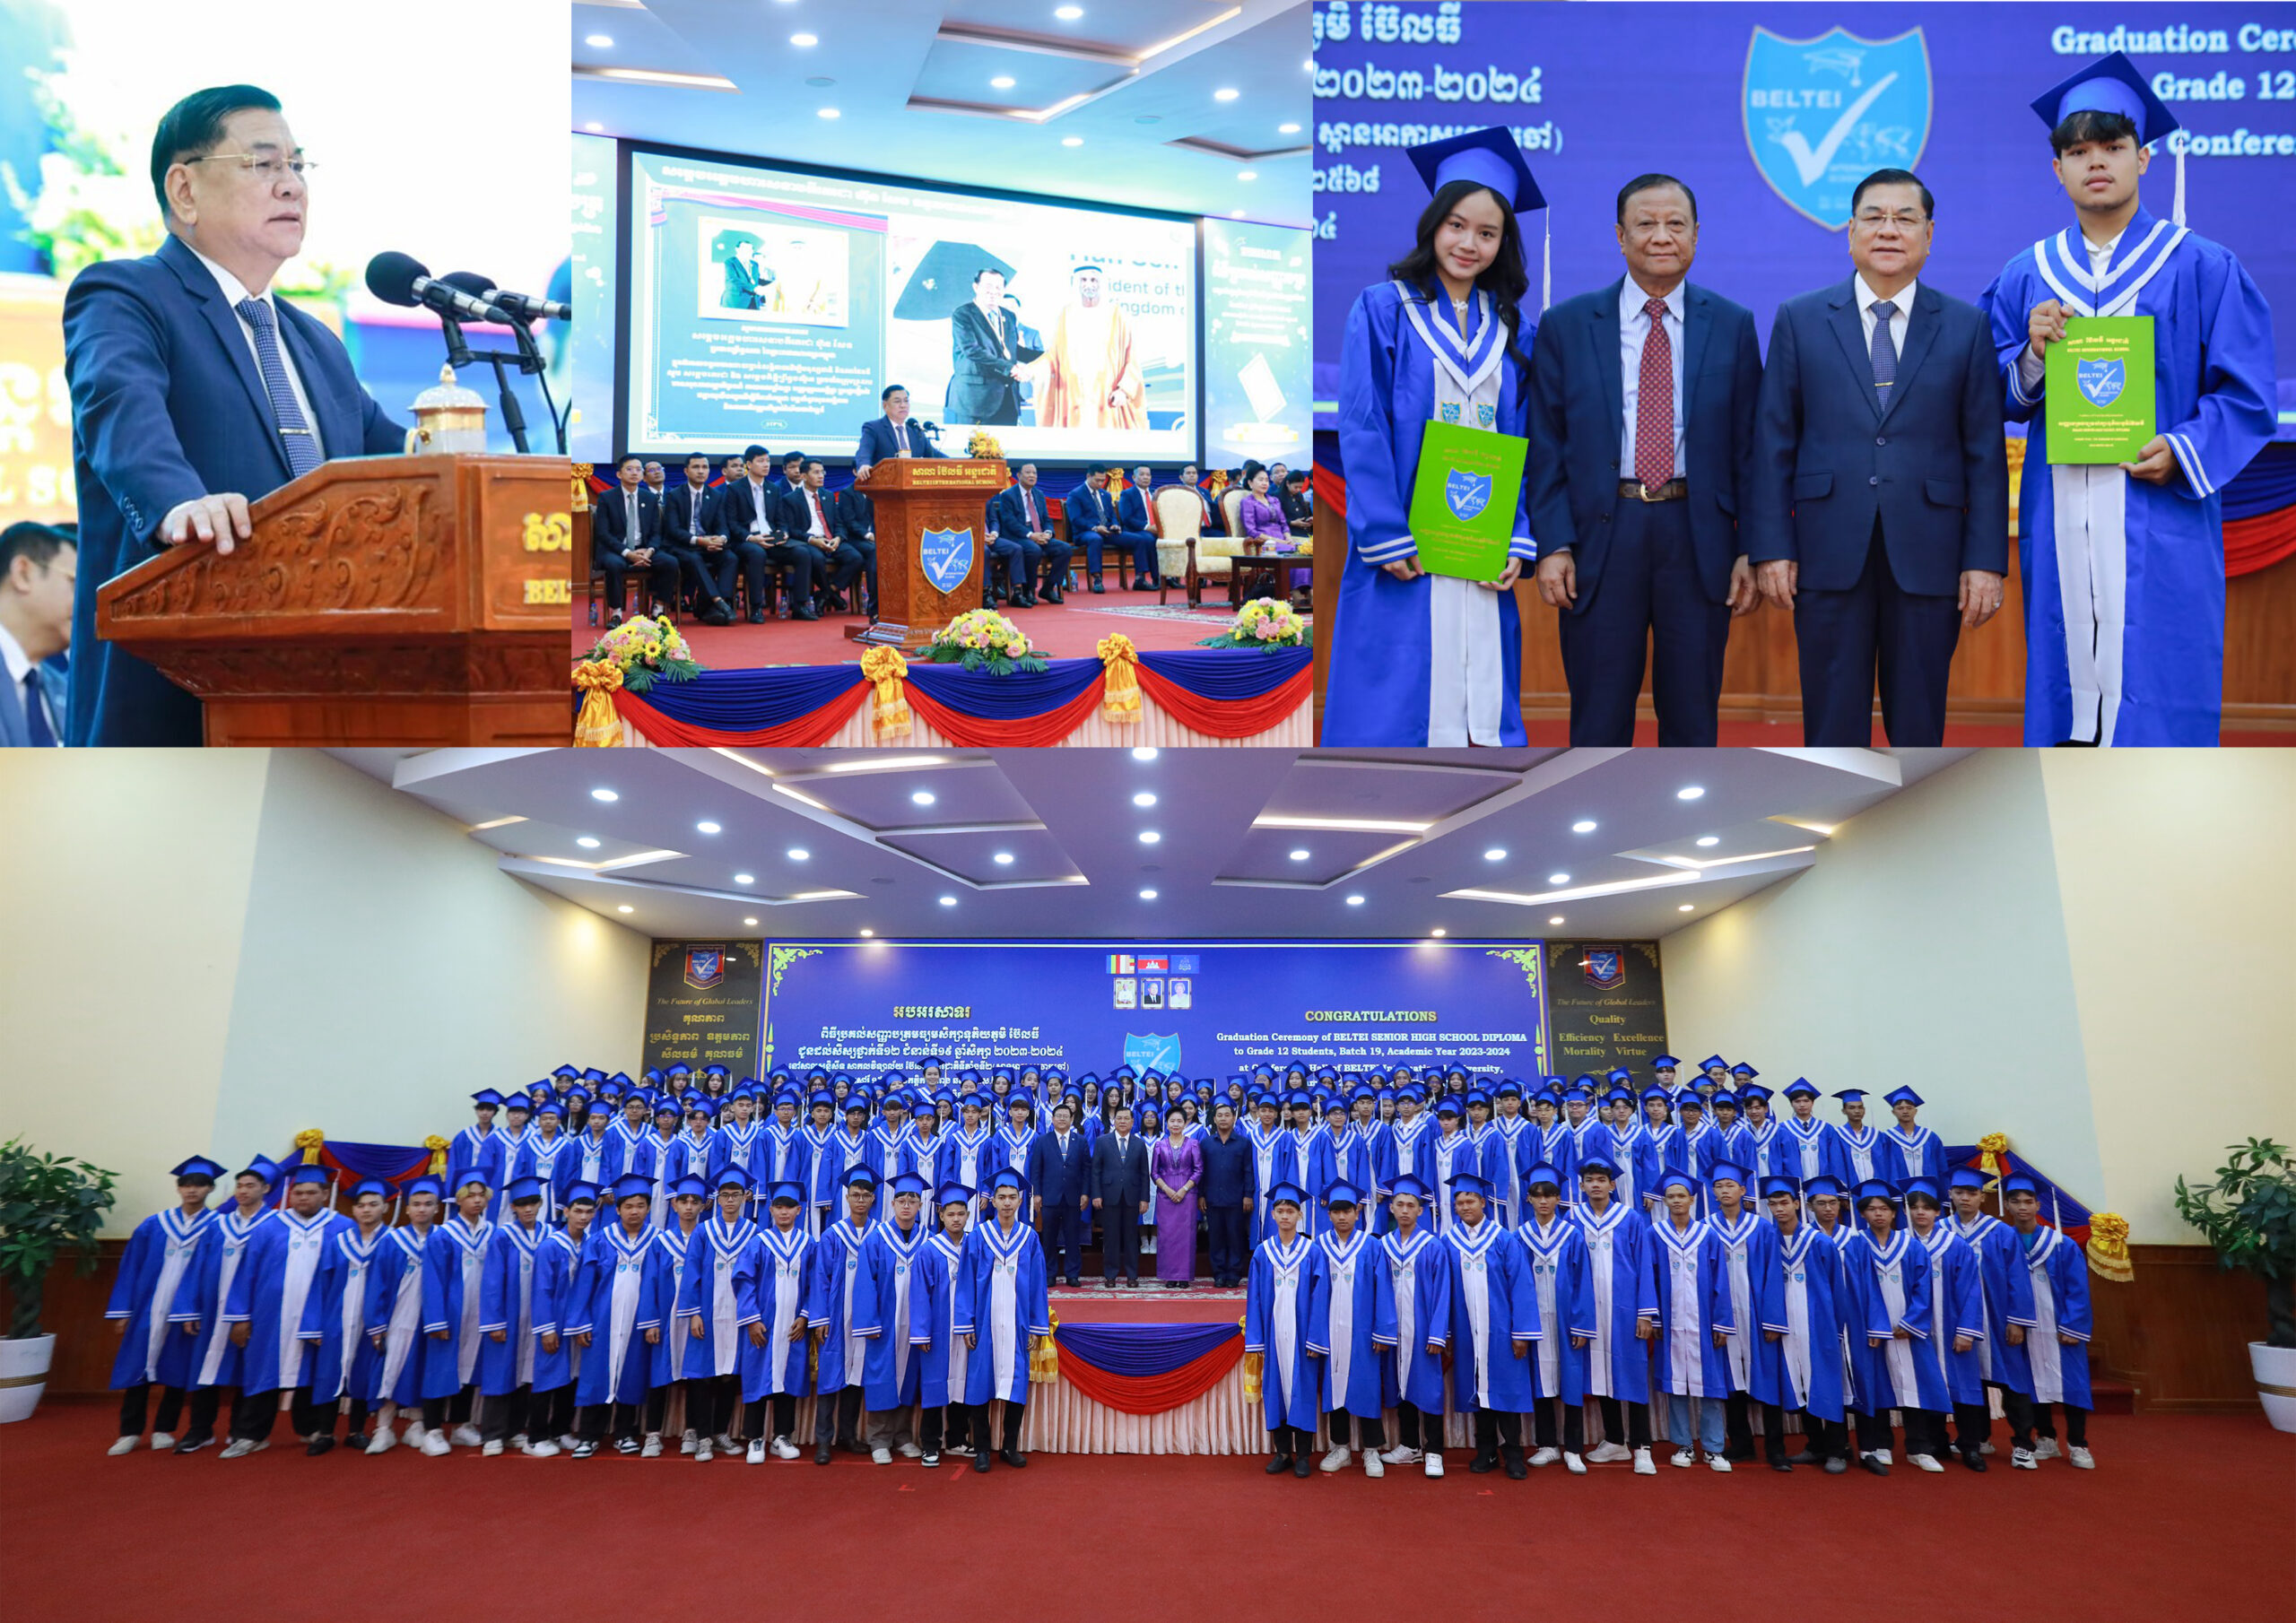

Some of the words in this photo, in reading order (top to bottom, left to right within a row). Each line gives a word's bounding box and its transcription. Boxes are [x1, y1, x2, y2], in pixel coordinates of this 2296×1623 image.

[2051, 23, 2230, 54] Graduation
[2152, 70, 2246, 100] Grade
[2257, 71, 2296, 100] 12
[1751, 90, 1841, 108] BELTEI
[2167, 127, 2296, 157] Confere
[1154, 282, 1170, 296] of
[912, 467, 935, 476] សាលា
[937, 464, 963, 476] ប៊ែលធី
[965, 464, 997, 479] អន្តរជាតិ
[1447, 482, 1471, 491] BELTEI
[694, 997, 701, 1006] of
[702, 997, 726, 1005] Global
[893, 1005, 971, 1019] អបអរសាទរ
[1305, 1011, 1437, 1022] CONGRATULATIONS
[683, 1014, 725, 1026] គុណភាព
[1589, 1014, 1626, 1026] Quality
[1216, 1033, 1269, 1042] Graduation
[1272, 1033, 1319, 1044] Ceremony
[1321, 1032, 1332, 1042] of
[1334, 1033, 1369, 1042] BELTEI
[1371, 1033, 1408, 1042] SENIOR
[1411, 1033, 1437, 1042] HIGH
[1439, 1033, 1480, 1042] SCHOOL
[1482, 1033, 1527, 1042] DIPLOMA
[1559, 1033, 1605, 1044] Efficiency
[1613, 1033, 1665, 1042] Excellence
[994, 1045, 1064, 1056] ២០២៣-២០២៤
[1234, 1046, 1244, 1055] to
[1247, 1046, 1274, 1055] Grade
[1277, 1046, 1289, 1055] 12
[1292, 1046, 1337, 1056] Students,
[1339, 1046, 1367, 1055] Batch
[1370, 1047, 1385, 1057] 19,
[1387, 1046, 1432, 1055] Academic
[1435, 1047, 1457, 1055] Year
[1459, 1047, 1510, 1056] 2023-2024
[1563, 1046, 1606, 1057] Morality
[1615, 1047, 1647, 1055] Virtue
[1239, 1064, 1248, 1072] at
